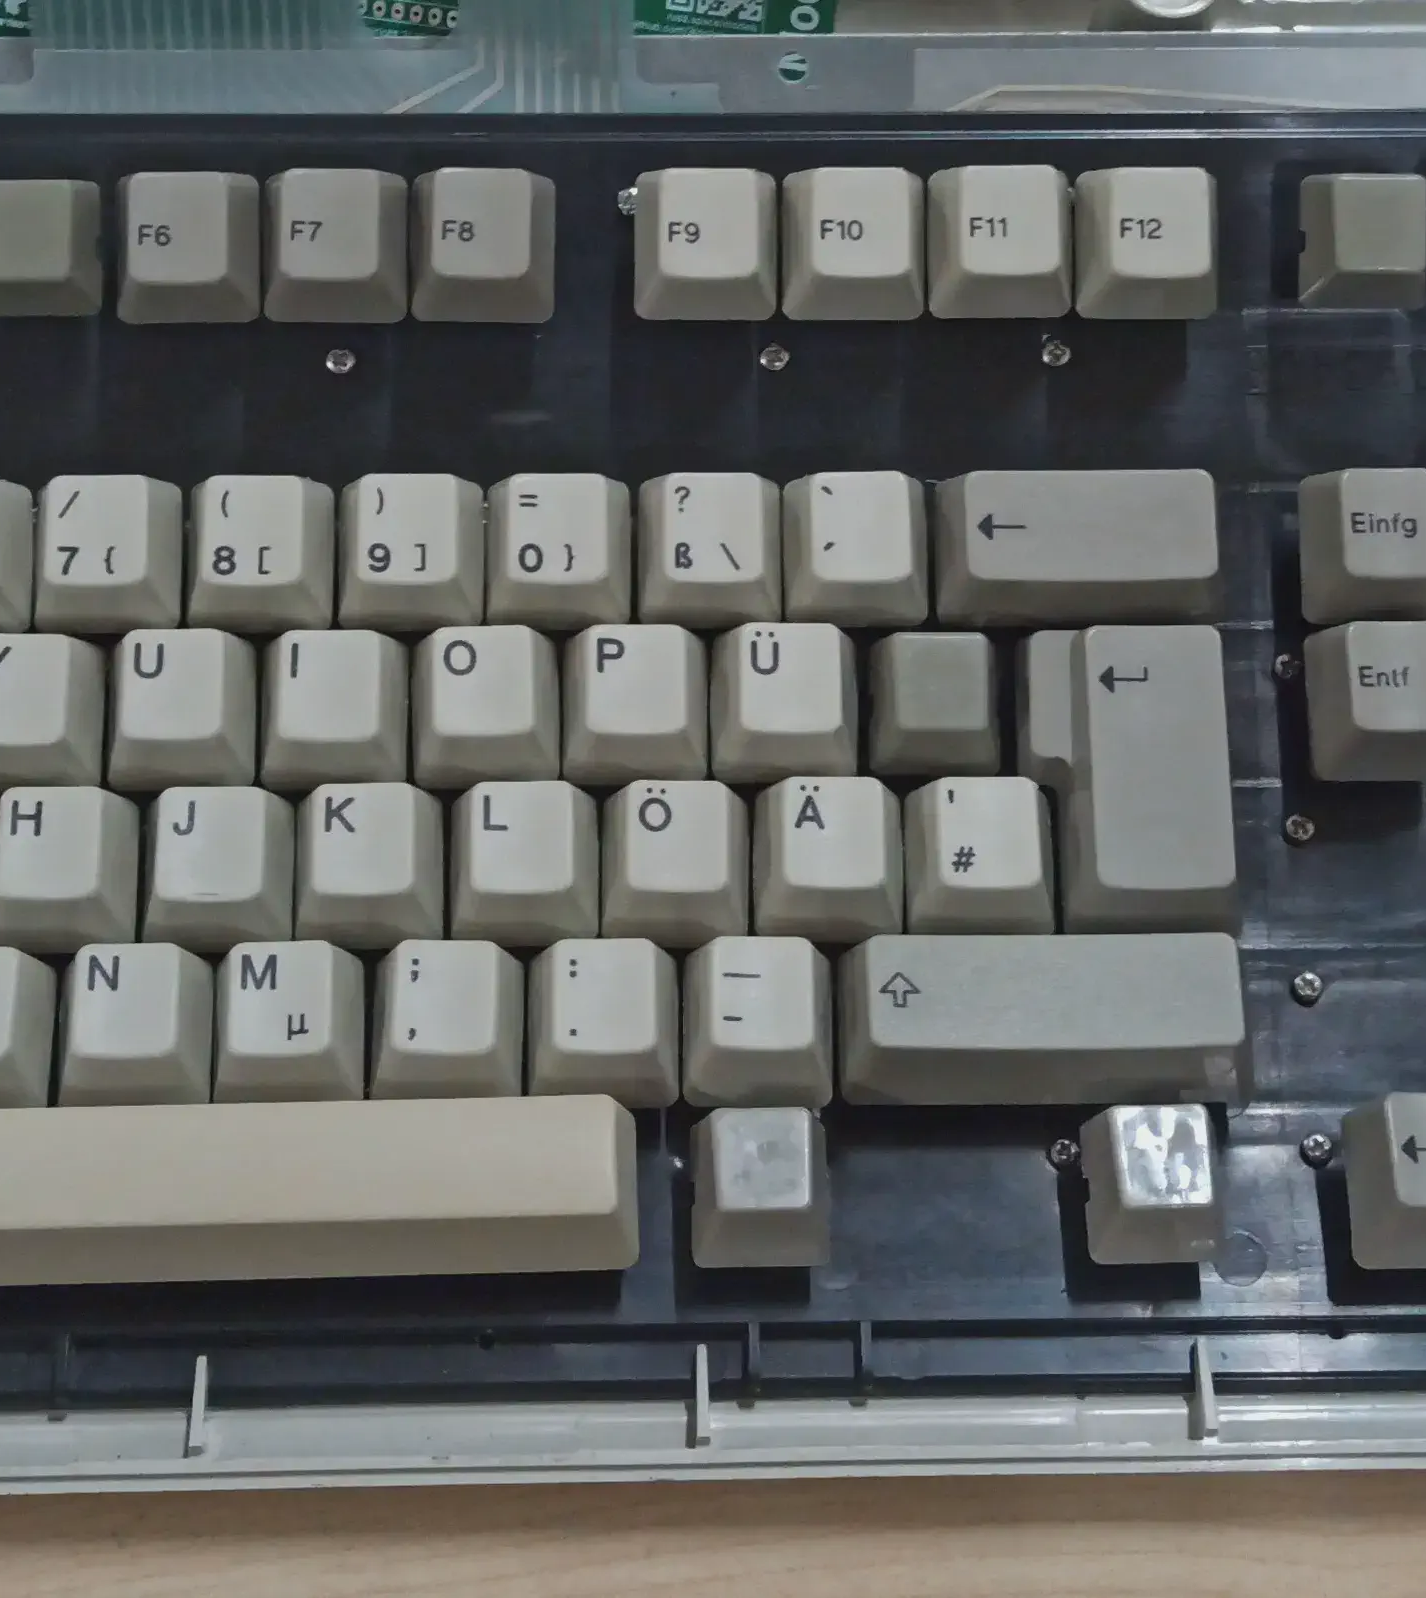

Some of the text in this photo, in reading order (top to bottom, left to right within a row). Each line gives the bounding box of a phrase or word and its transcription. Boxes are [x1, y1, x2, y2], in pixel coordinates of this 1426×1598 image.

[137, 224, 172, 247] F6
[290, 220, 324, 242] F7
[440, 219, 476, 243] F8
[668, 221, 701, 244] F9
[820, 218, 864, 241] F10
[969, 216, 1007, 238] F11
[1119, 217, 1163, 240] F12
[57, 490, 81, 519] /
[518, 494, 538, 508] =
[674, 485, 691, 513] ?
[1350, 511, 1418, 539] Einfg
[56, 546, 80, 576] 7
[211, 545, 271, 576] 8 [
[367, 542, 427, 573] 9 ]
[517, 543, 544, 574] 0
[674, 542, 741, 571] ß \
[133, 642, 165, 680] U
[443, 639, 478, 676] O
[596, 637, 625, 674] P
[750, 630, 780, 676] Ü
[1357, 665, 1410, 688] Entf
[9, 799, 44, 837] H
[172, 800, 196, 837] J
[324, 796, 356, 833] K
[482, 794, 509, 832] L
[638, 787, 673, 833] Ö
[794, 784, 826, 830] Ä
[951, 845, 976, 873] #
[87, 954, 121, 992] N
[240, 953, 278, 991] M
